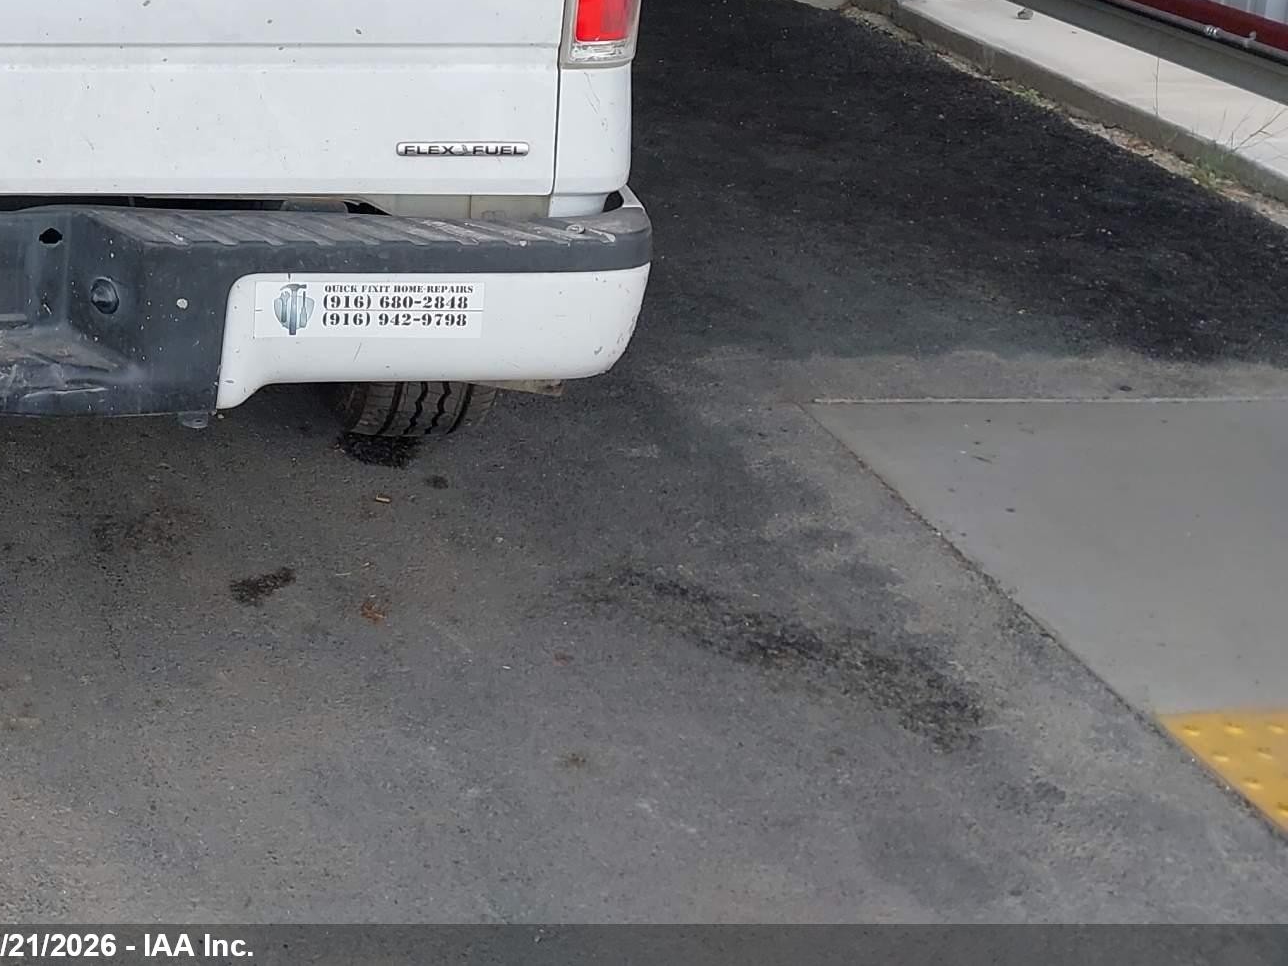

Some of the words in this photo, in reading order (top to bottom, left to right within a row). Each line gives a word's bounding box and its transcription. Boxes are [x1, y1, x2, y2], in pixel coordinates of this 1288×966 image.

[403, 145, 454, 155] FLEX
[472, 145, 524, 155] FUEL
[324, 285, 357, 293] QUICK
[361, 285, 390, 293] FIXIT
[393, 285, 423, 293] HOME
[426, 285, 474, 294] REPAIRS
[323, 295, 372, 310] (916)
[379, 295, 469, 309] 680-2848
[322, 312, 371, 327] (916)
[378, 313, 468, 327] 942-9798
